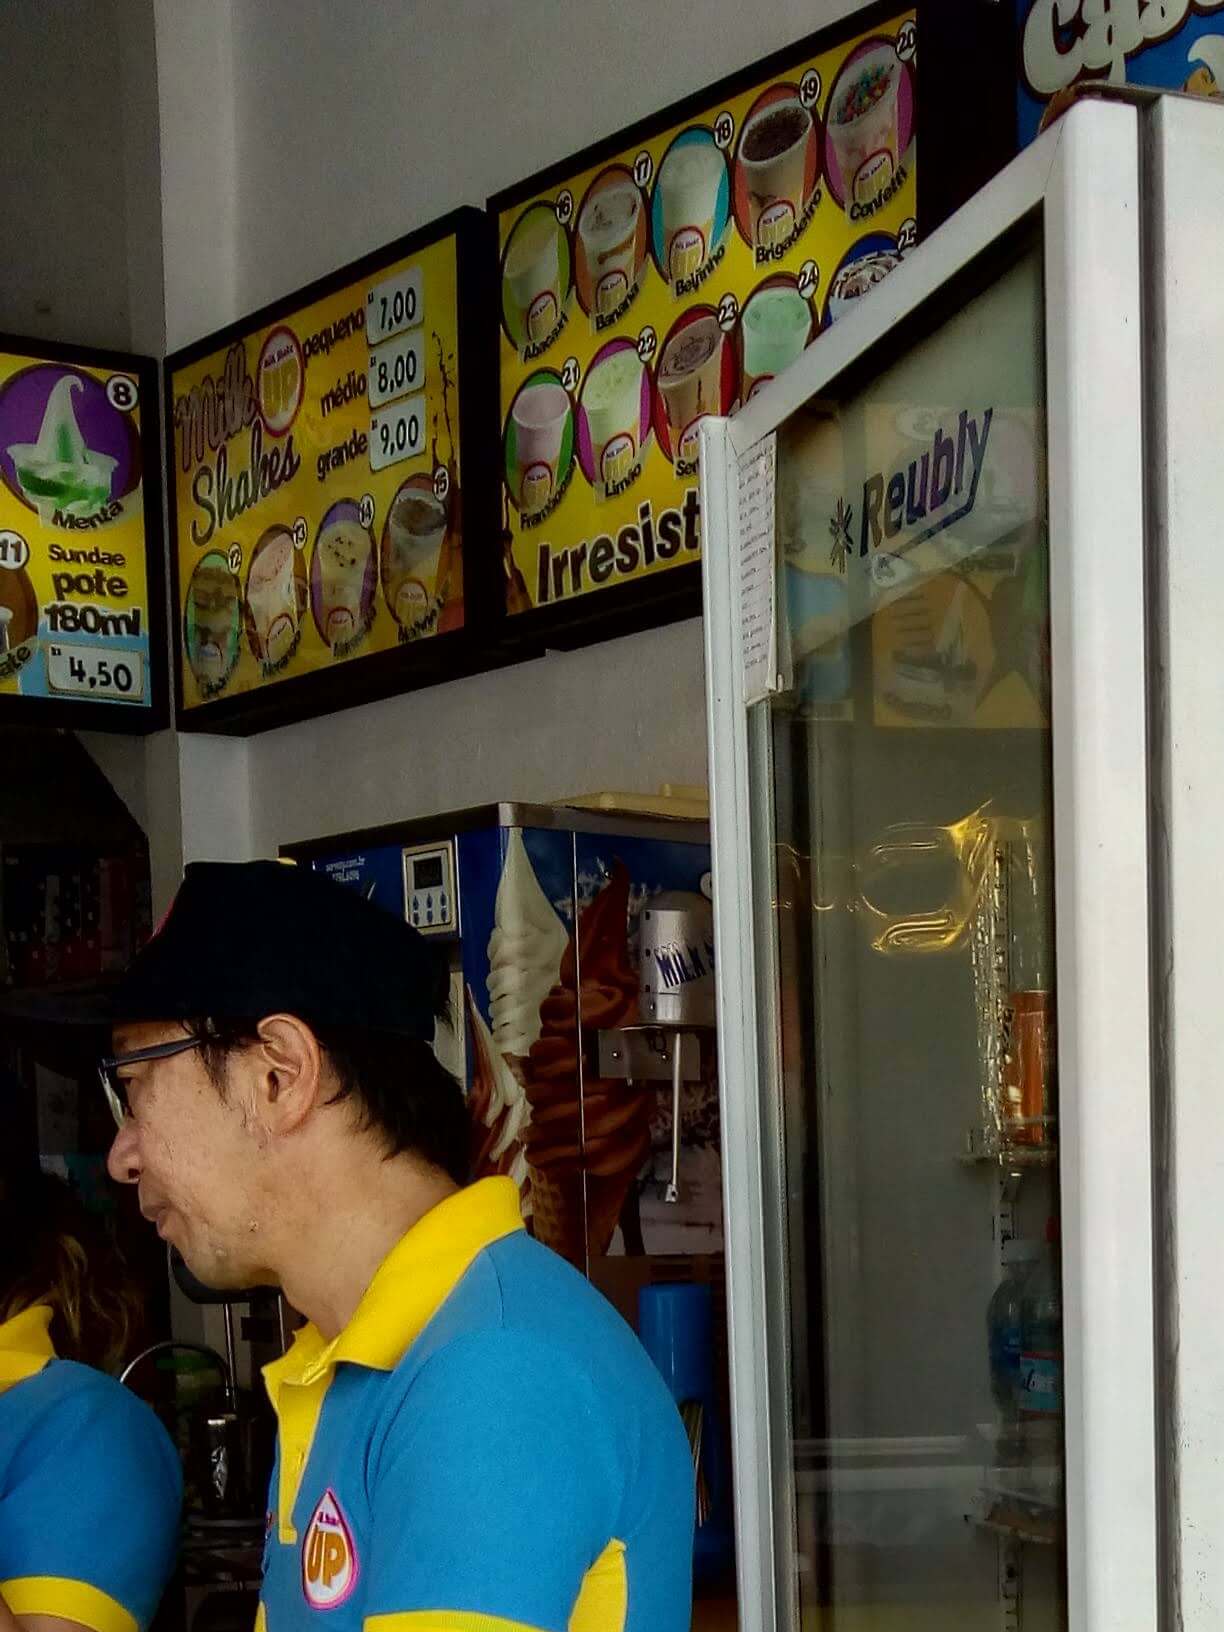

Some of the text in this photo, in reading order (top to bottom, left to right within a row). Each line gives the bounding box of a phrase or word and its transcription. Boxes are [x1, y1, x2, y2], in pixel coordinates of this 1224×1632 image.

[802, 75, 818, 100] 19
[715, 117, 733, 143] 18
[635, 158, 651, 182] 17
[557, 193, 571, 218] 16
[756, 188, 821, 263] Brigadeiro
[302, 306, 365, 369] pequeno
[320, 349, 417, 418] médio 8,00
[563, 364, 579, 386] 21
[113, 383, 132, 405] 8
[316, 414, 419, 482] grande 9,00
[859, 407, 994, 557] Reubly
[52, 501, 124, 530] Menta
[50, 543, 126, 567] Sundae
[52, 568, 128, 601] pote
[45, 604, 141, 636] 180ml
[69, 656, 132, 691] 4,50
[307, 1526, 347, 1589] UP
